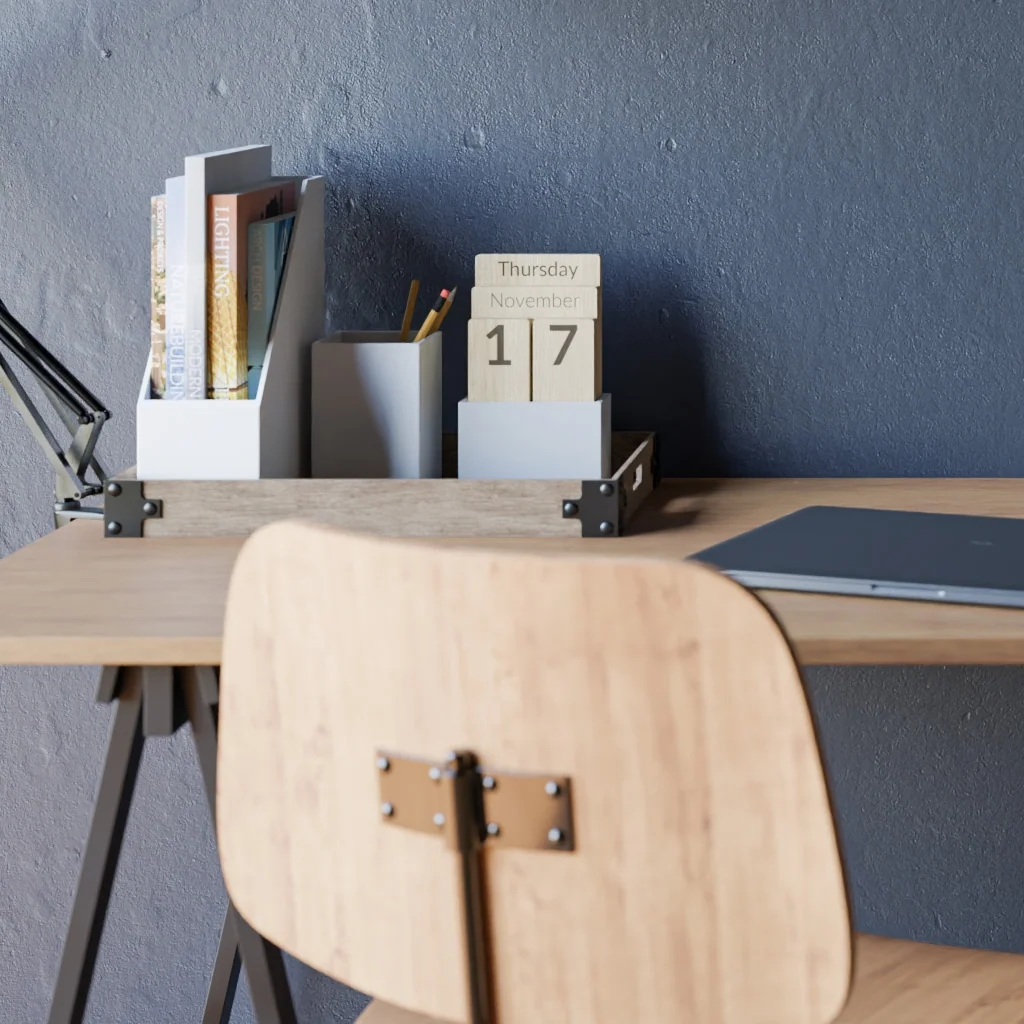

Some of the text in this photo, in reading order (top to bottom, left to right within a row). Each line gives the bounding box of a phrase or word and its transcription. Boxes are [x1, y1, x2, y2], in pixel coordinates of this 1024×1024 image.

[213, 206, 230, 297] LIGHTING
[498, 261, 578, 280] Thursday
[251, 265, 263, 312] DESIGN
[490, 292, 581, 308] November
[188, 329, 203, 398] MODERN
